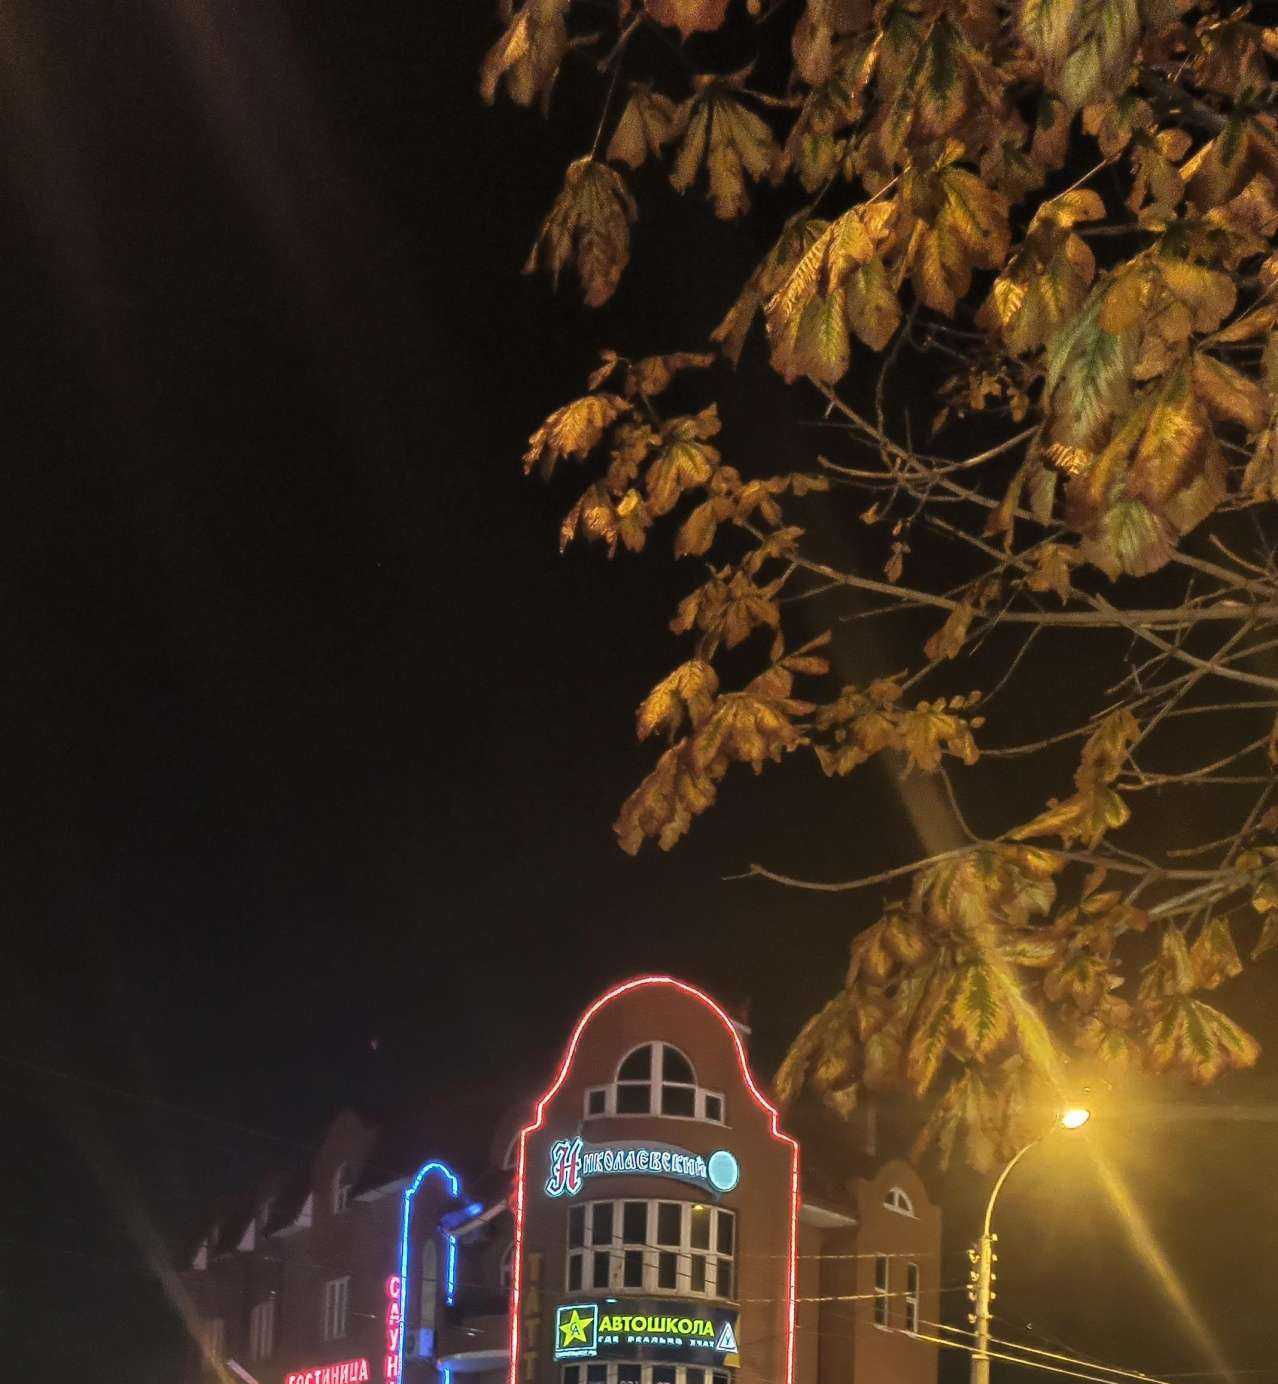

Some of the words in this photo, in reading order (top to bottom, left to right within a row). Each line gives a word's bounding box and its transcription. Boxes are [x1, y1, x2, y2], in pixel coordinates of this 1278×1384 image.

[599, 1316, 714, 1336] АВТОШКОЛА
[598, 1335, 619, 1344] ГДЕ
[627, 1335, 683, 1345] РЕАЛЬНО
